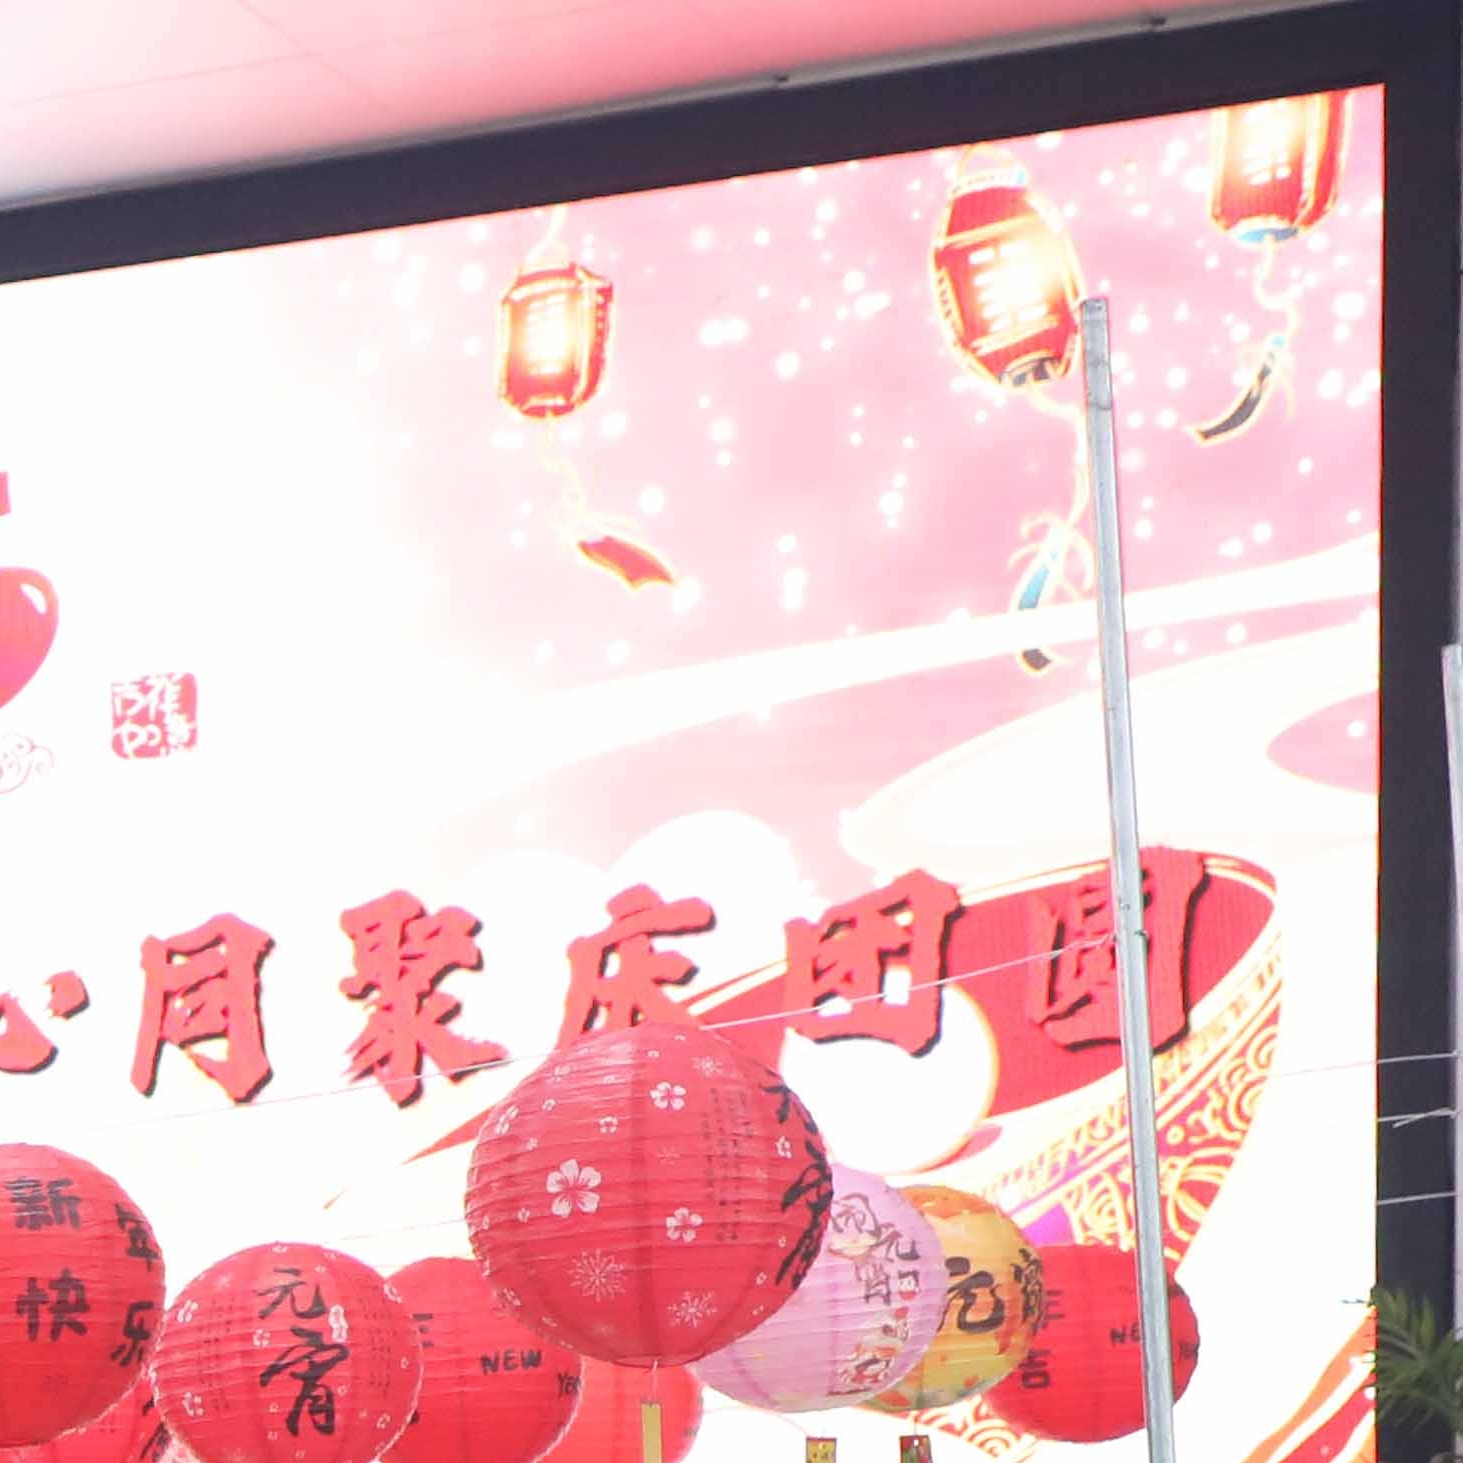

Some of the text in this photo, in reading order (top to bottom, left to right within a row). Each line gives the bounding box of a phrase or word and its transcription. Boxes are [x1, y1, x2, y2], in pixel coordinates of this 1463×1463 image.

[1111, 1321, 1141, 1347] NE
[254, 1267, 349, 1437] 元宵
[481, 1349, 542, 1375] NEW
